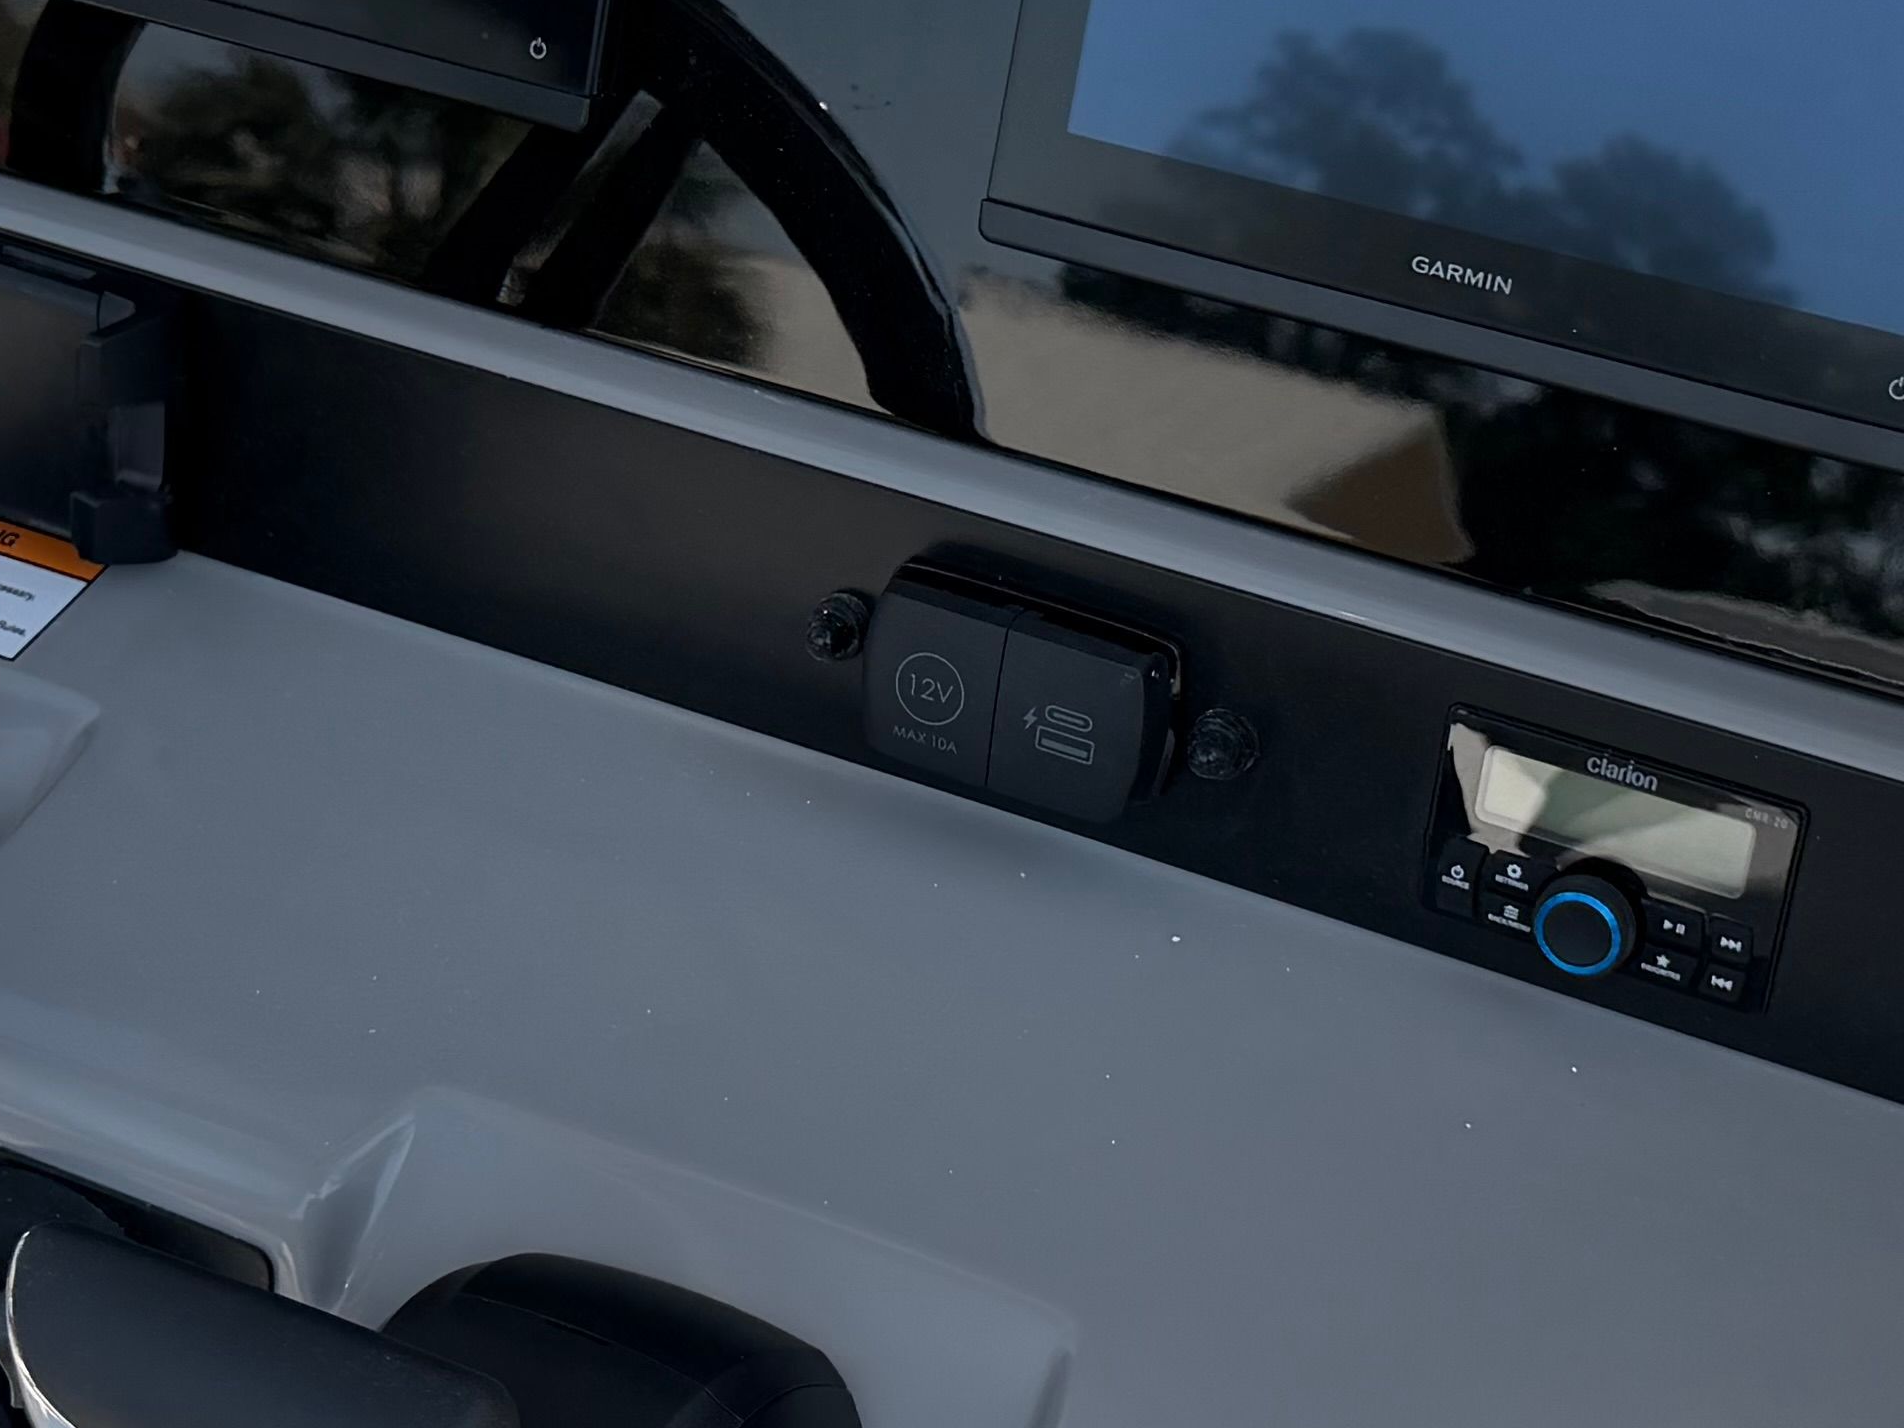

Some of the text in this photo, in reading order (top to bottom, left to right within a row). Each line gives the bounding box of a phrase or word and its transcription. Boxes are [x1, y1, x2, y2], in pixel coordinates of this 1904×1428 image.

[1411, 255, 1512, 295] GARMIN
[911, 673, 954, 703] 12V
[893, 725, 957, 755] MAX 10A
